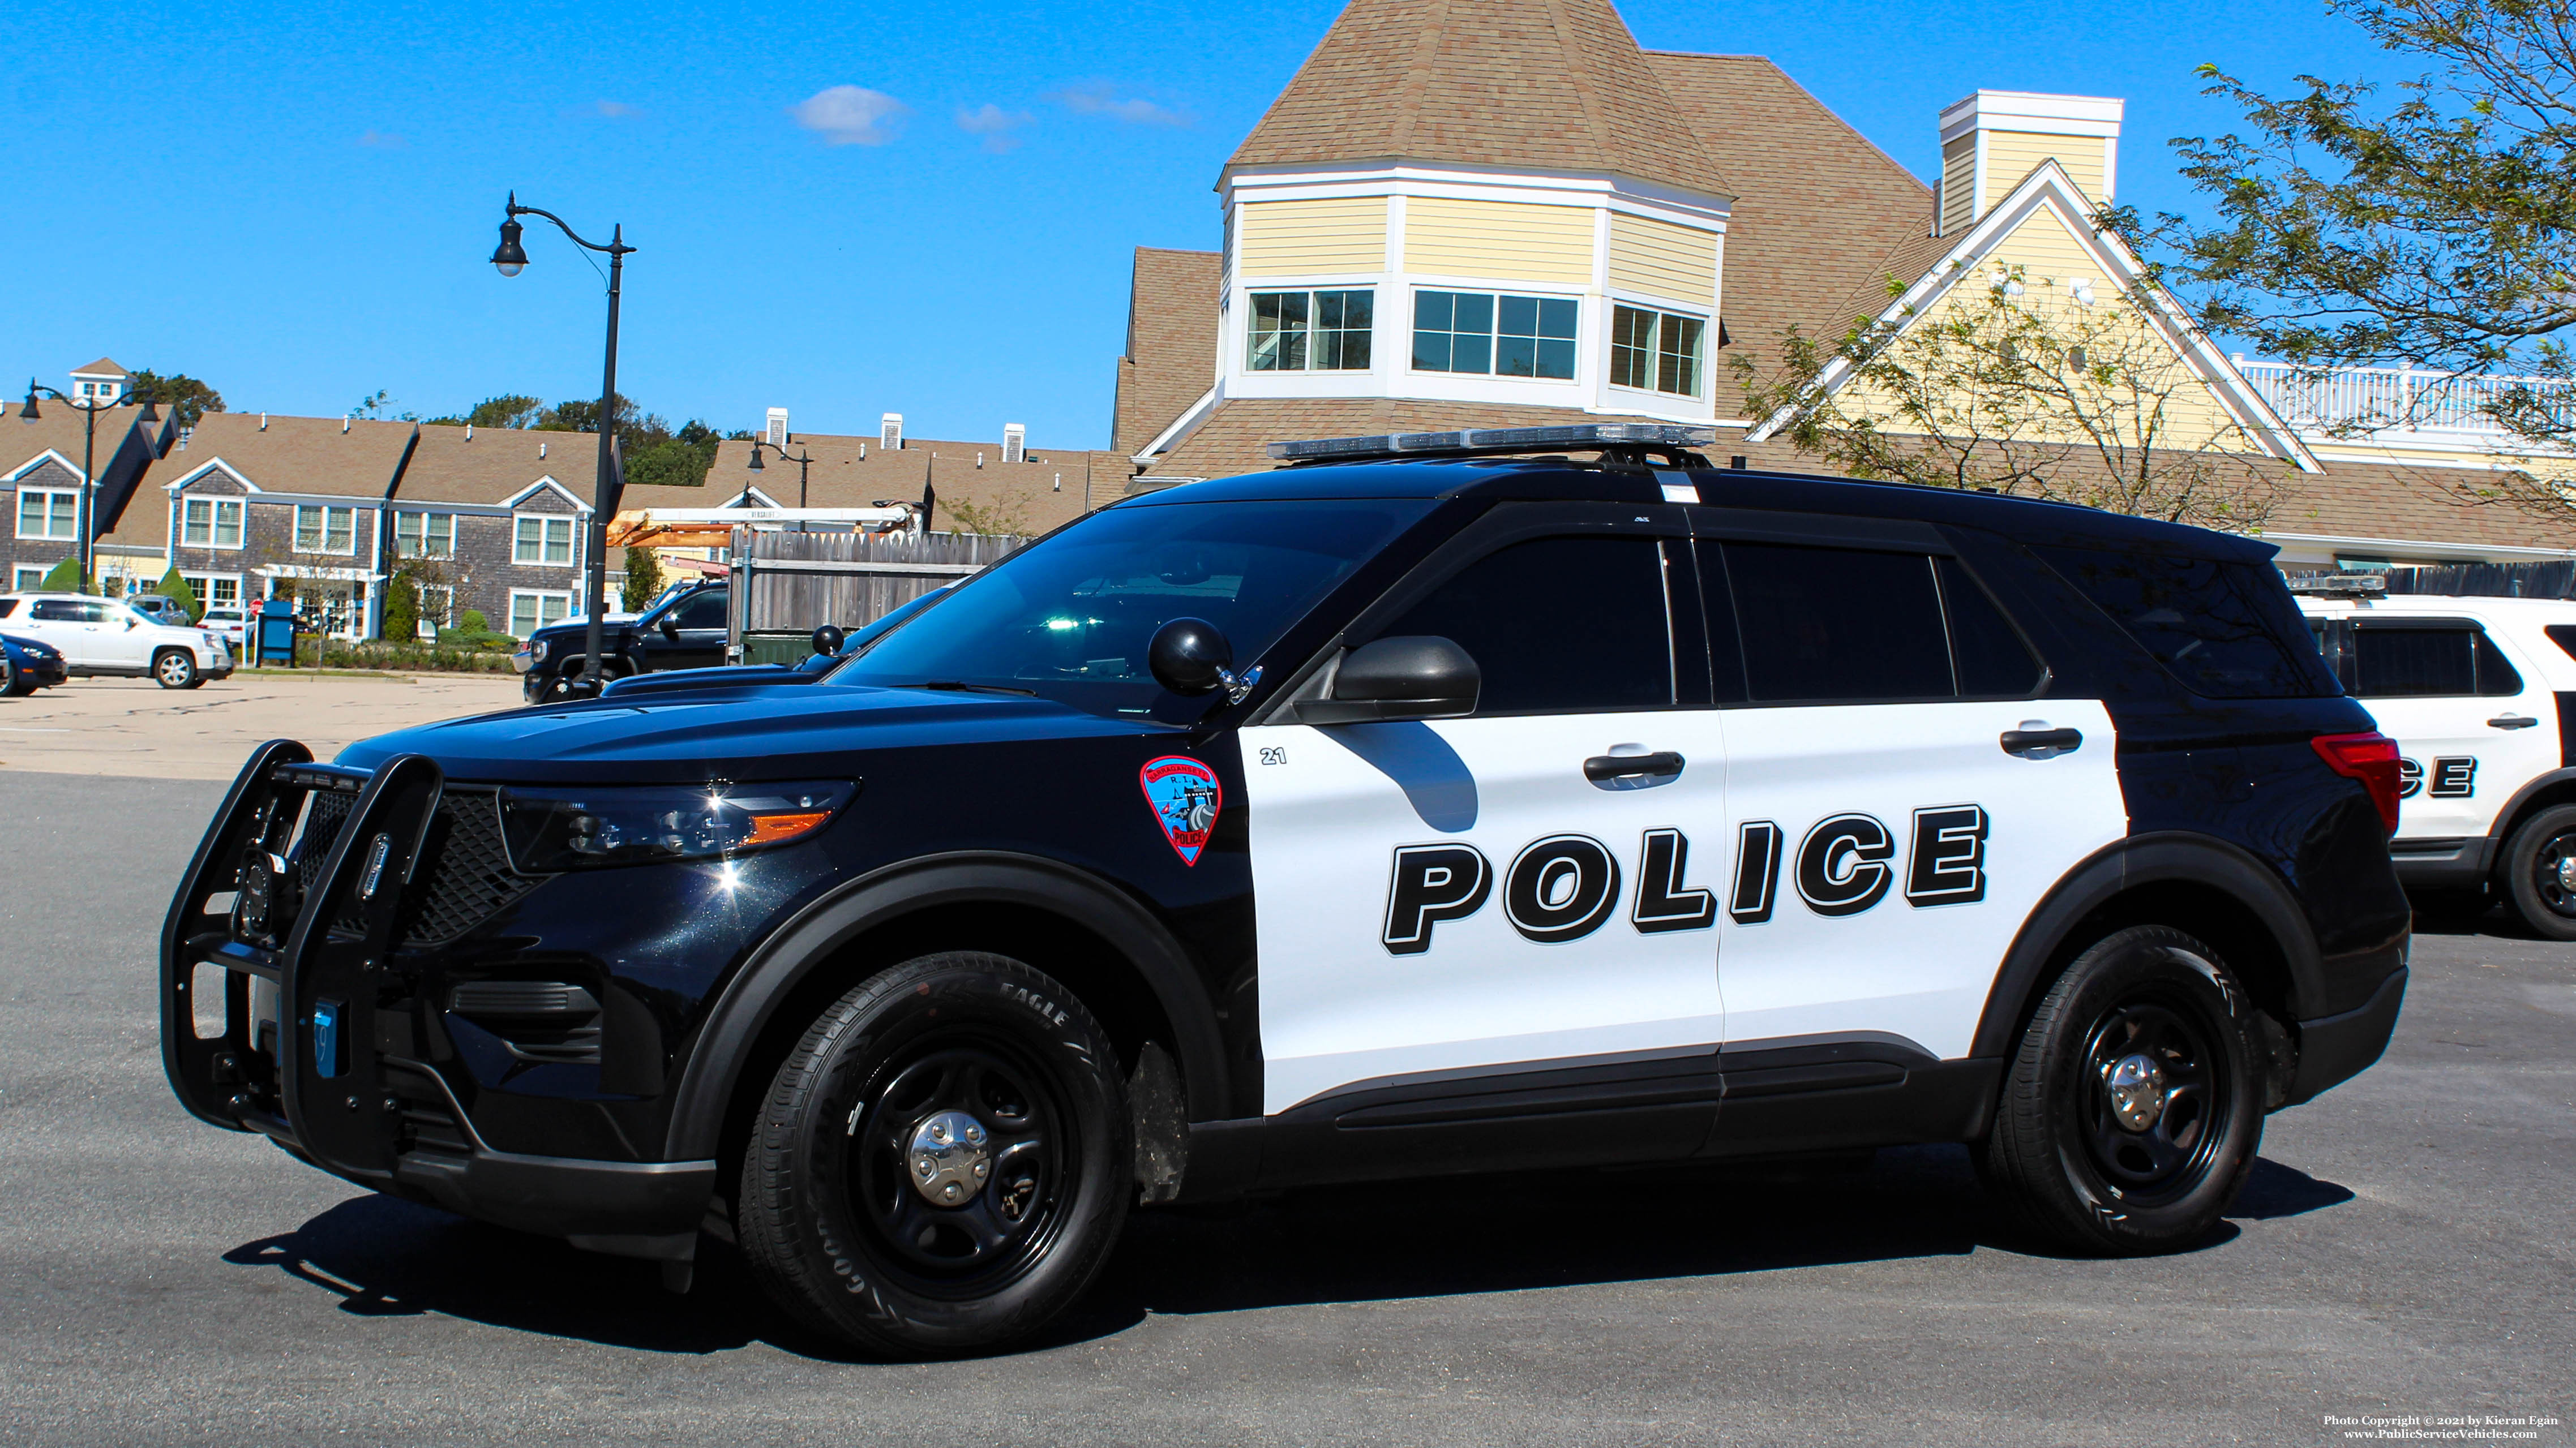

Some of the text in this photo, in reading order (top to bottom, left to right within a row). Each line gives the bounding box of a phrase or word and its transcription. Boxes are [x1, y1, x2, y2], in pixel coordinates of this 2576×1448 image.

[1259, 747, 1287, 765] 21
[1149, 766, 1206, 780] NARRAGANSETT
[1173, 831, 1203, 845] POLICE
[1381, 803, 1989, 957] POLICE
[998, 983, 1069, 1026] EAGLE
